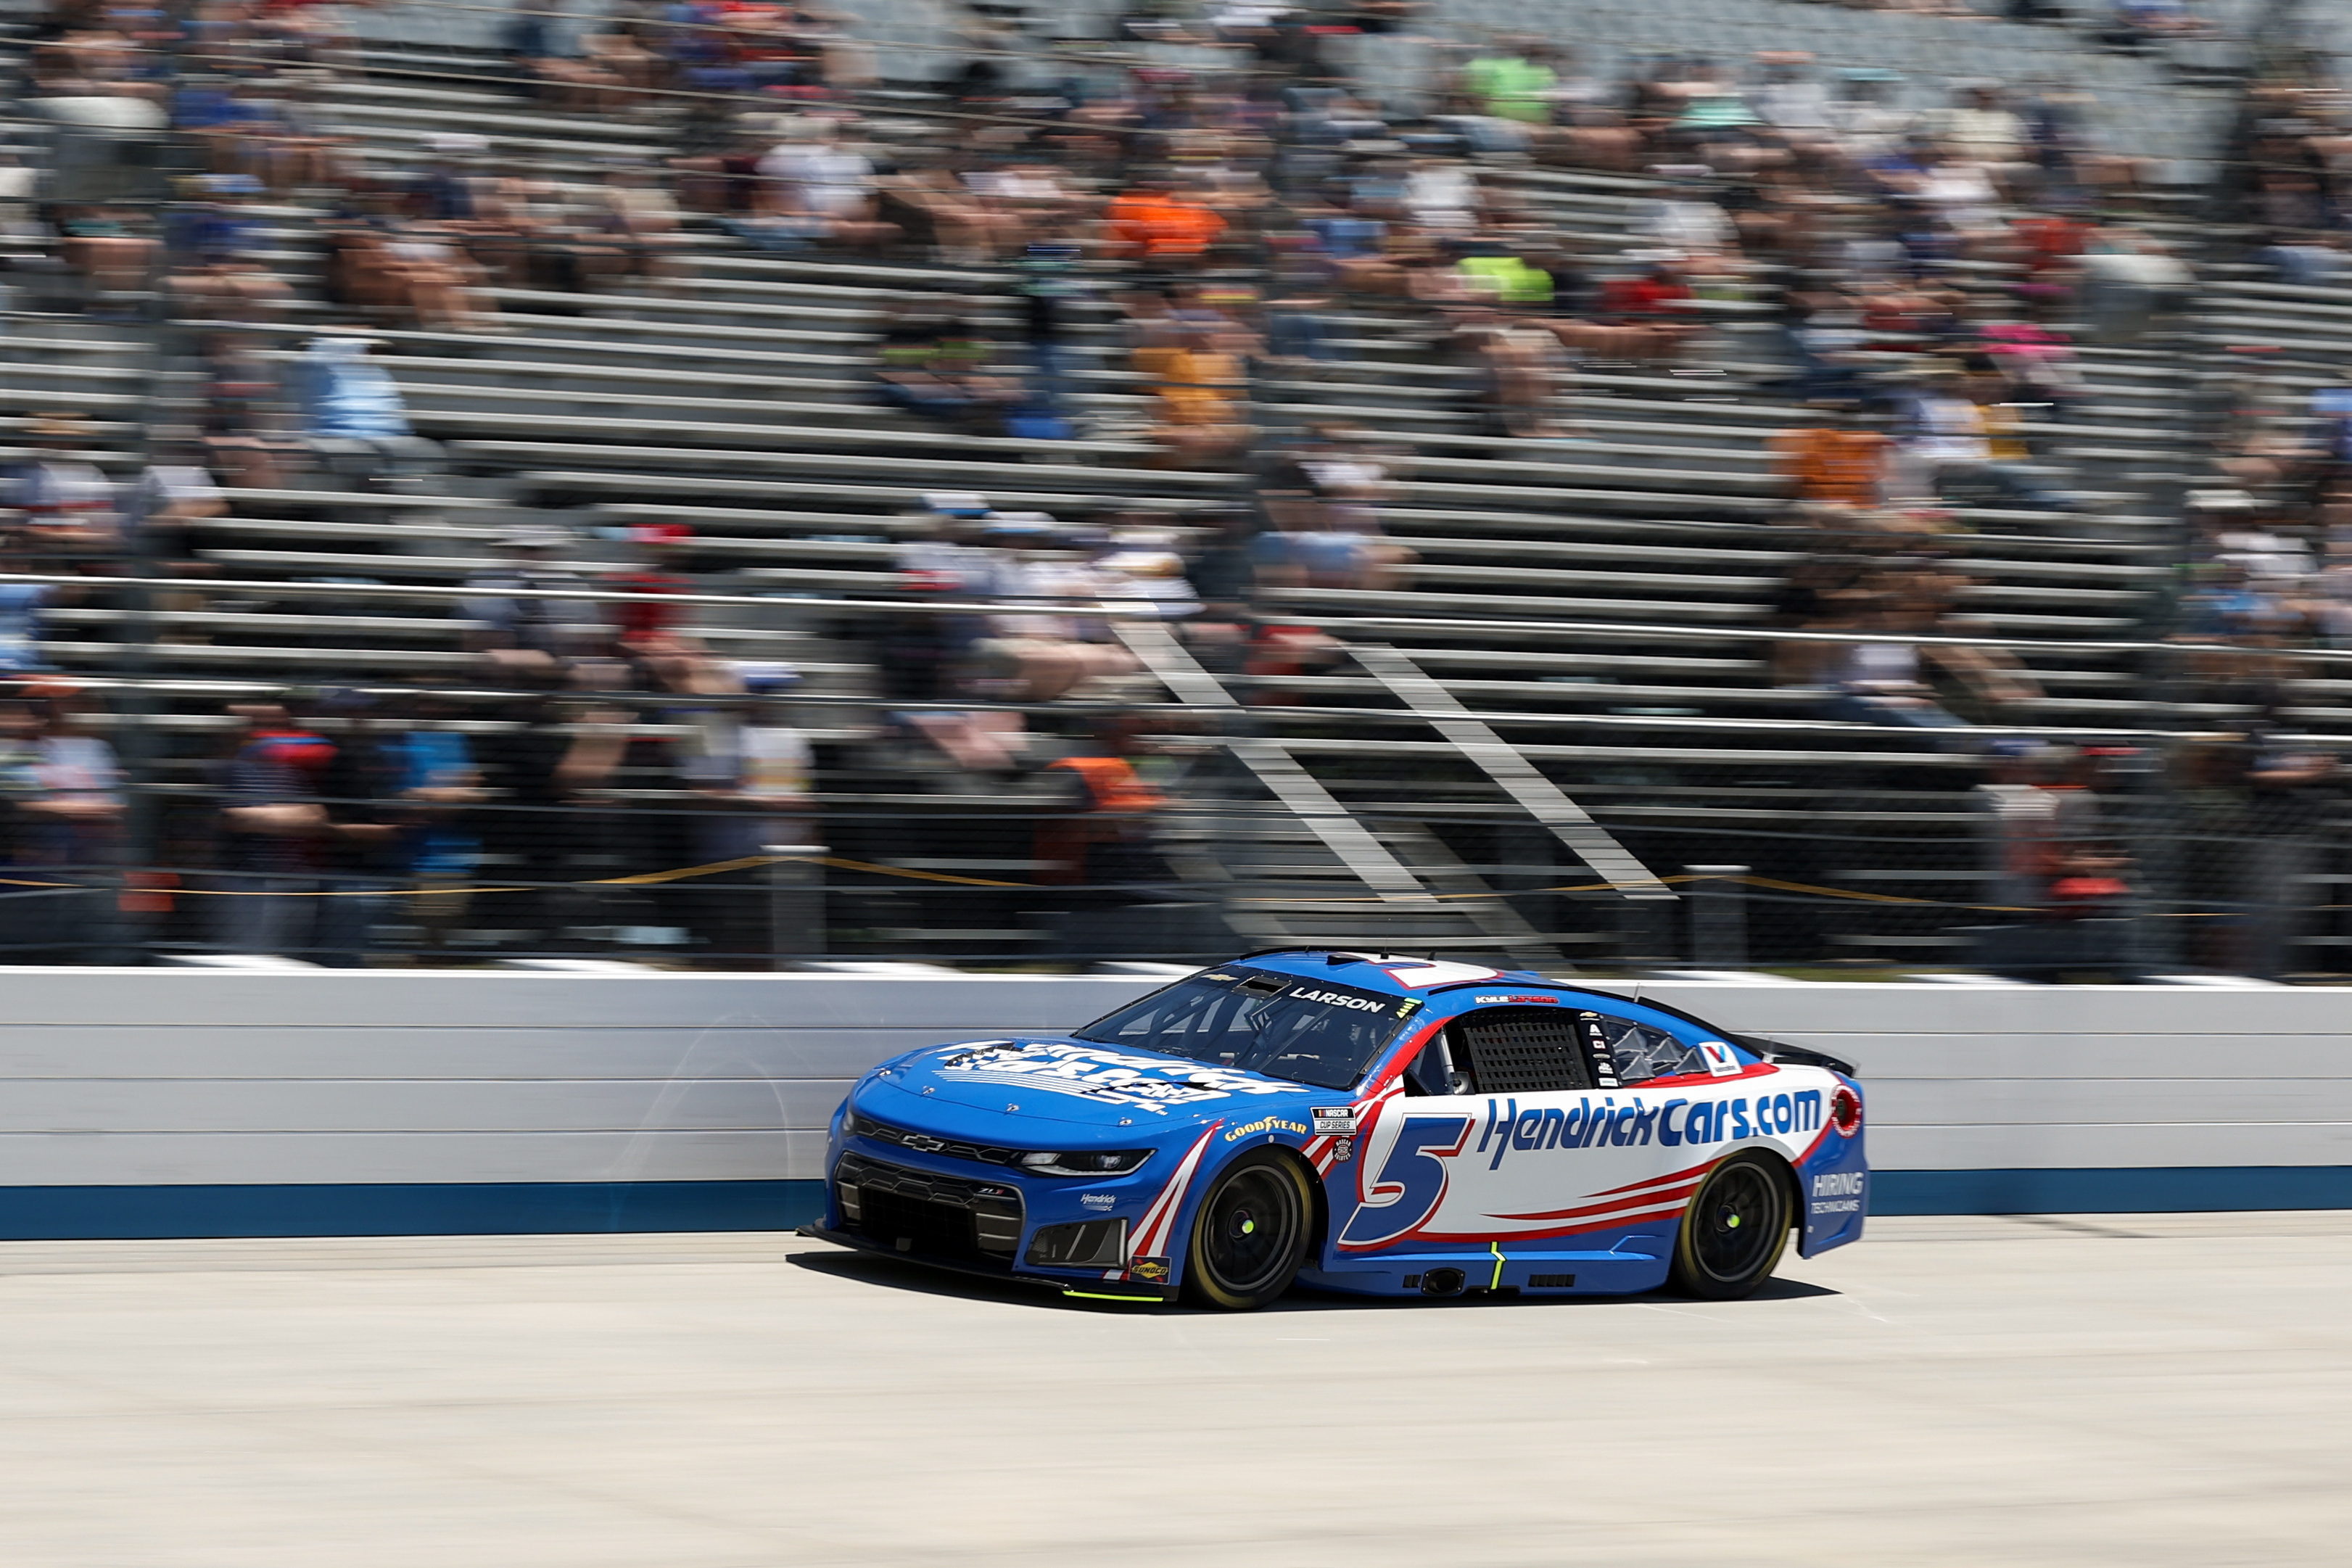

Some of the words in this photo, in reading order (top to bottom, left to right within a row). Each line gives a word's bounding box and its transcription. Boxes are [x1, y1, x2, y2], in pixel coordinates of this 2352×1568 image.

[1289, 987, 1386, 1013] LARSON
[1477, 1089, 1821, 1171] HendrickCars.com
[1337, 1113, 1477, 1253] 5
[1812, 1172, 1864, 1197] HIRING
[1080, 1194, 1116, 1204] Hendrick
